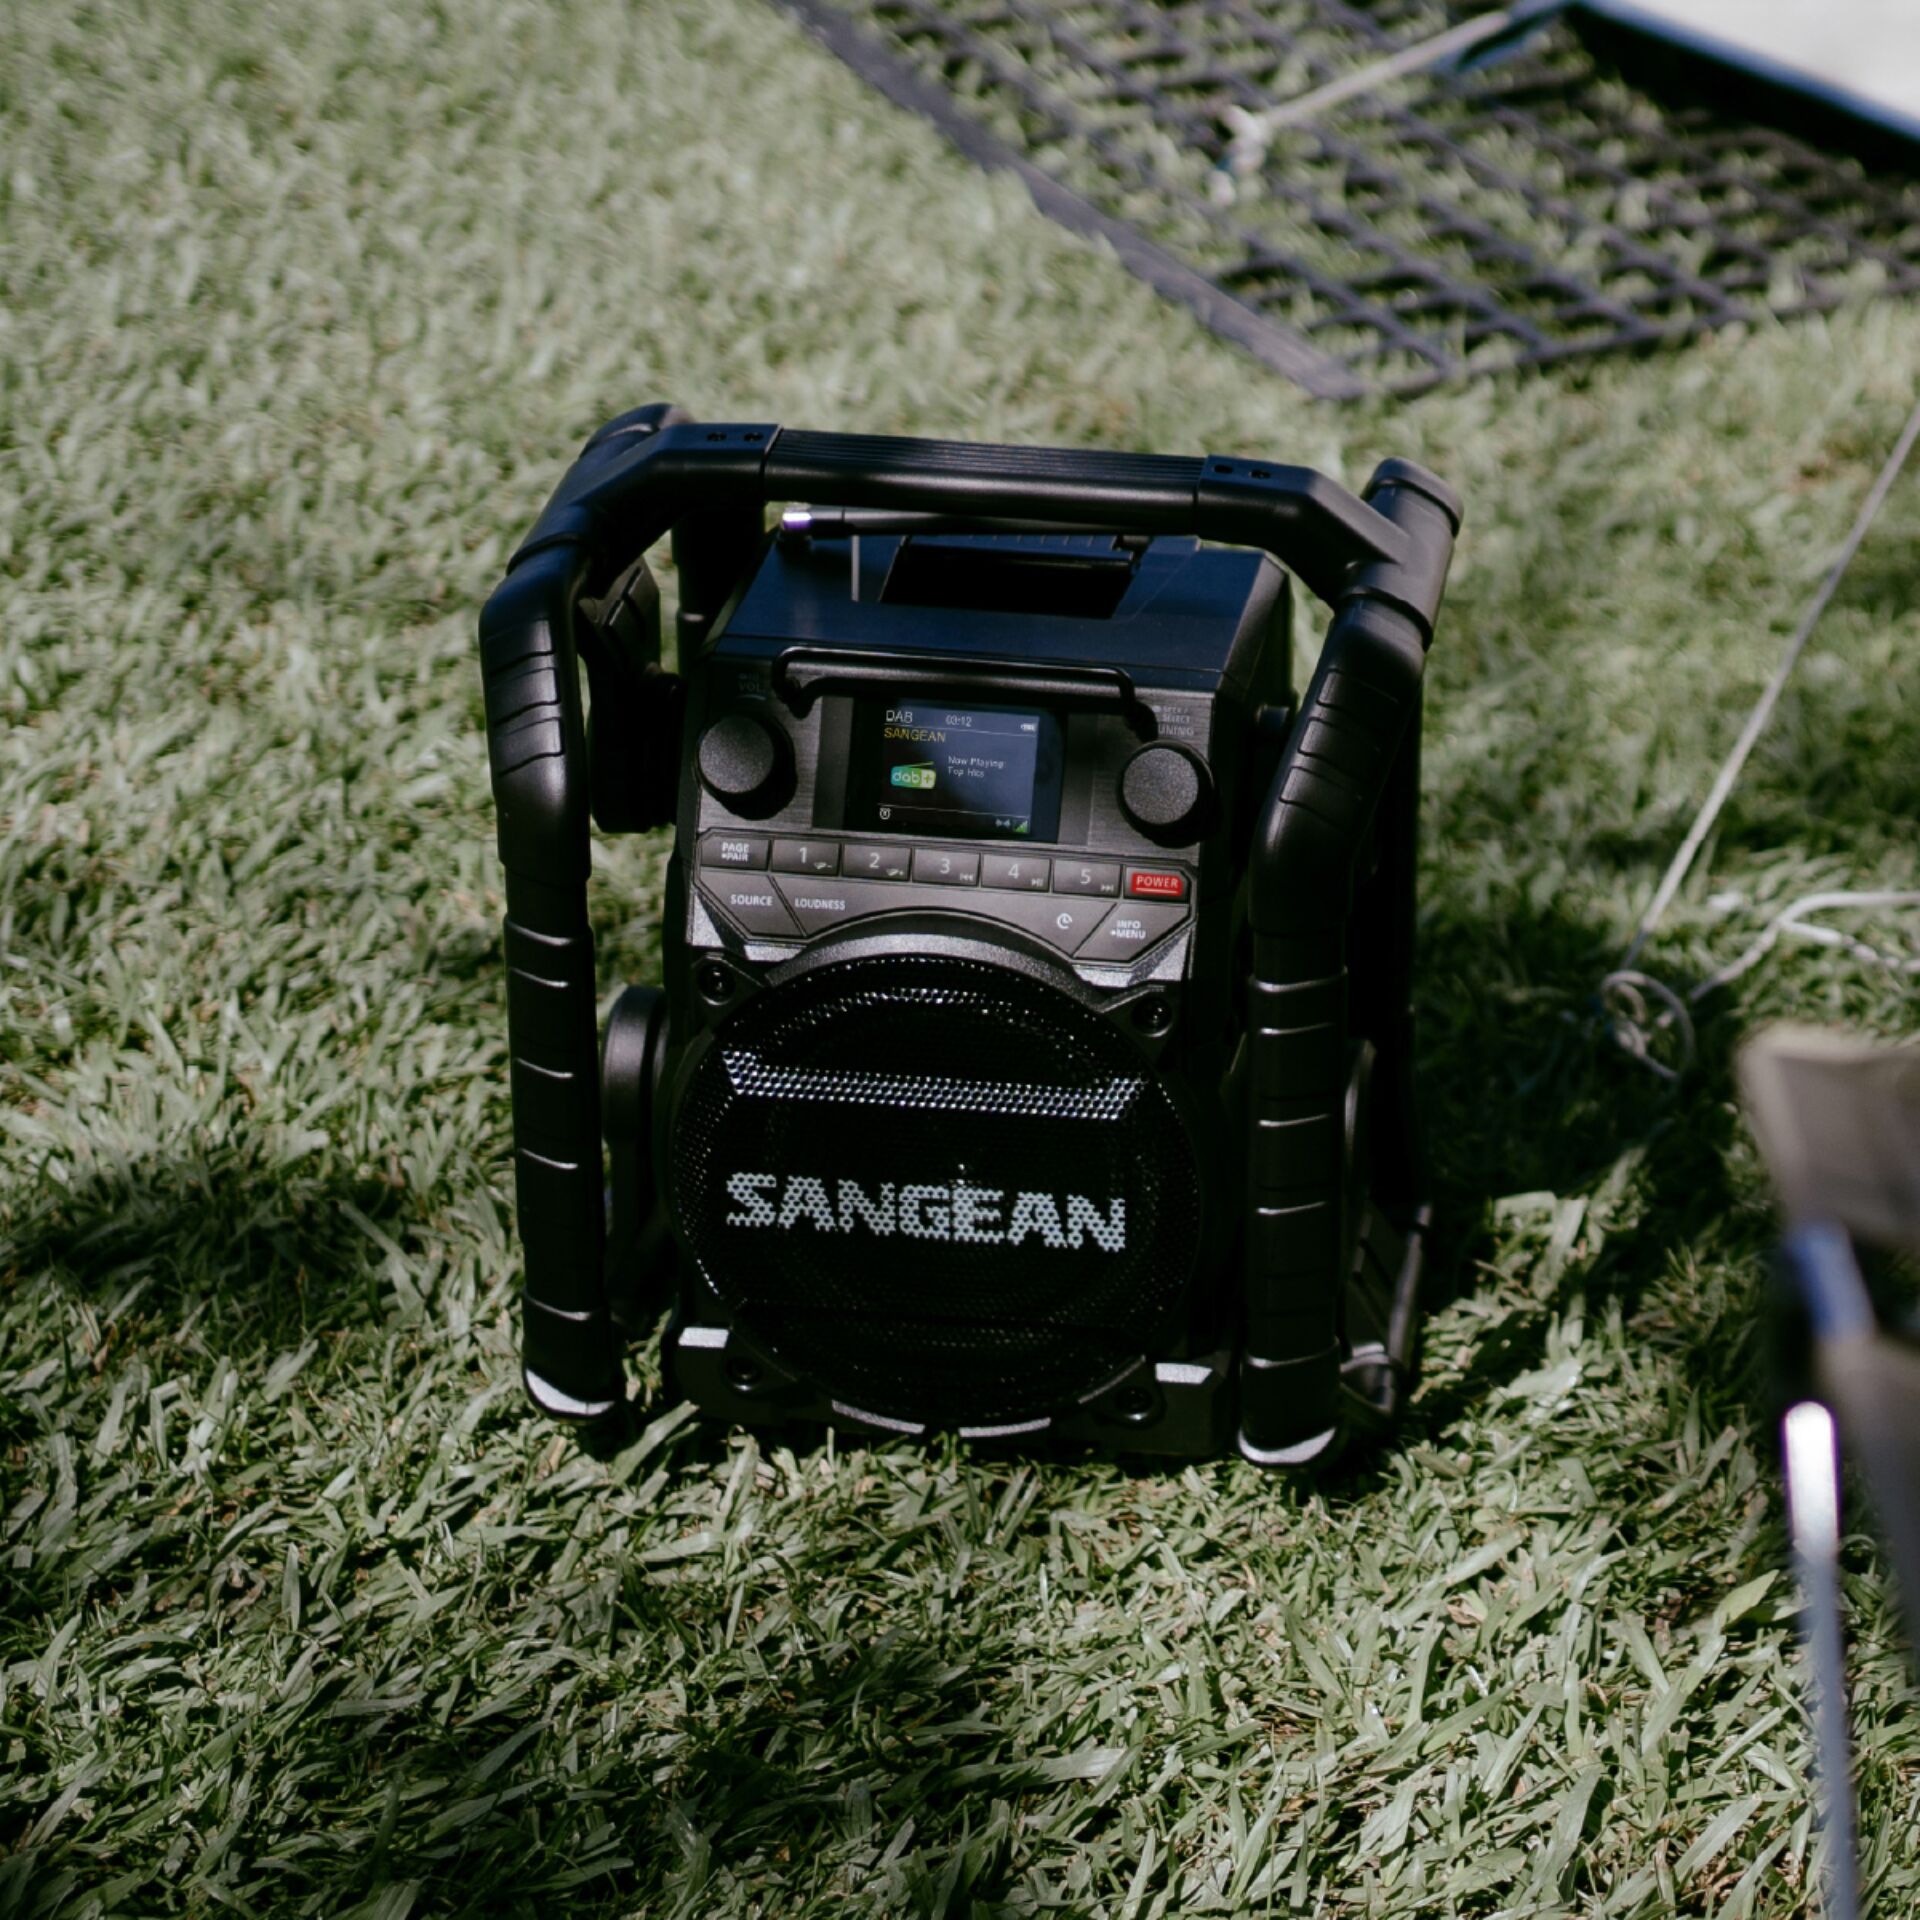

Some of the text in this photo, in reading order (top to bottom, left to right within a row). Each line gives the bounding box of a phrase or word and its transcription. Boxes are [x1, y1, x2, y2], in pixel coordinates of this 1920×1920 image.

[886, 710, 913, 724] DAB
[884, 727, 946, 743] SANGEAN
[1157, 724, 1194, 737] UNING
[799, 847, 808, 863] 1
[869, 852, 880, 868] 2
[939, 858, 950, 874] 3
[1008, 863, 1020, 879] 4
[1080, 869, 1092, 885] 5
[1136, 876, 1179, 889] POWER
[730, 894, 774, 906] SOURCE
[795, 897, 846, 911] LOUDNESS
[1116, 919, 1141, 929] INFO
[727, 1172, 1126, 1252] SANGEAN
